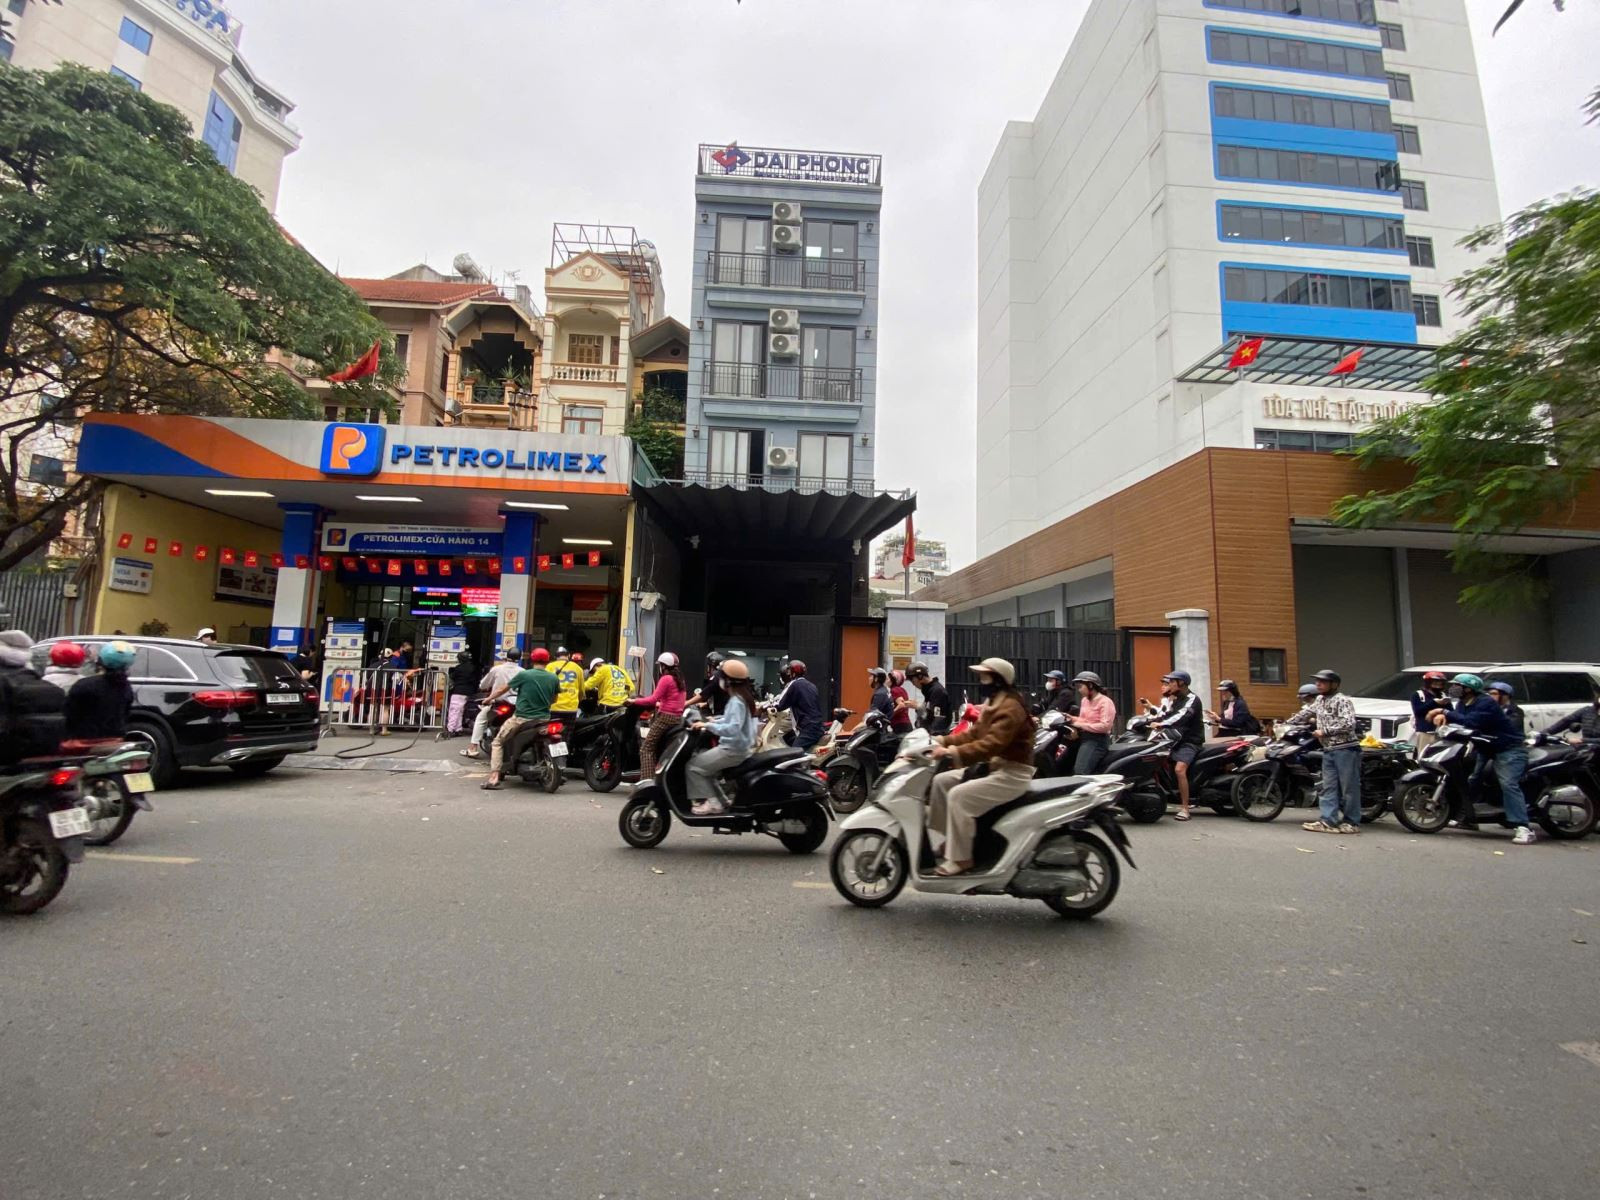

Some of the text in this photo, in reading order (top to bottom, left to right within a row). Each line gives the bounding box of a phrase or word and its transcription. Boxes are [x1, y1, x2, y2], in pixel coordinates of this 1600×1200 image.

[796, 154, 871, 174] PHONG
[1264, 393, 1294, 417] TÒA
[1301, 395, 1330, 420] NHÀ
[1337, 397, 1365, 424] TẬP
[391, 443, 607, 474] PETROLIMEX
[478, 537, 489, 546] 14
